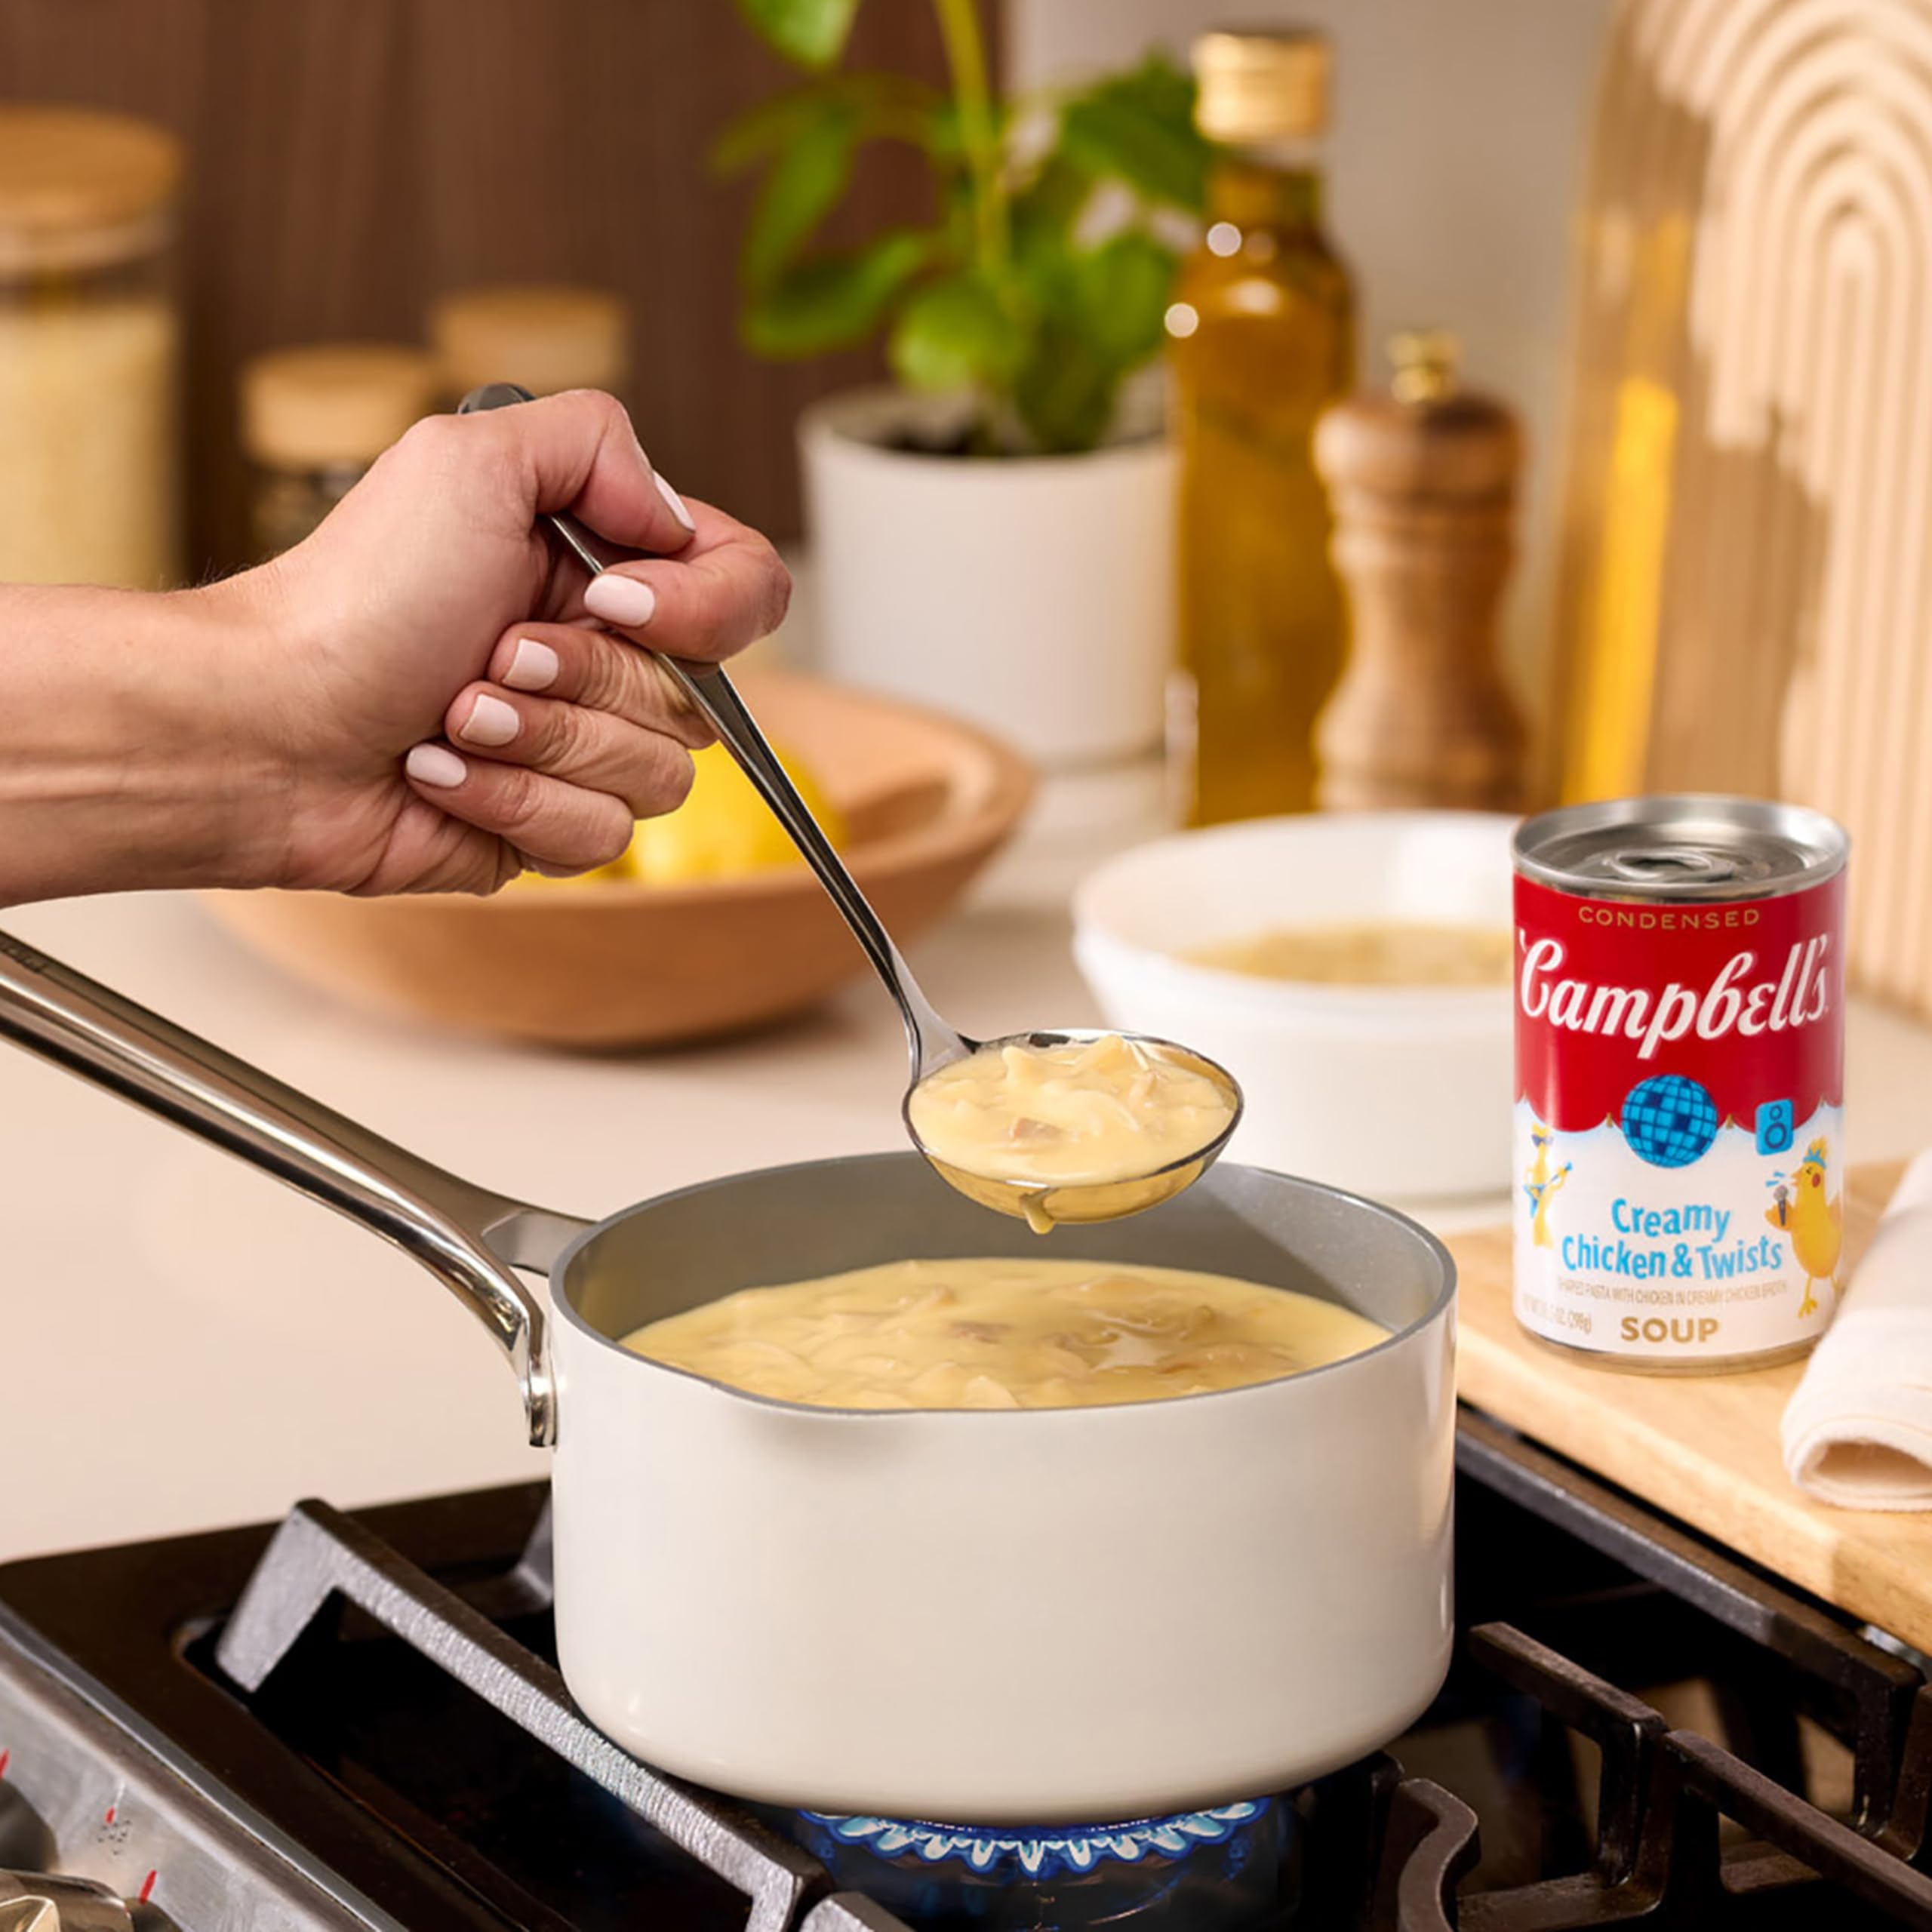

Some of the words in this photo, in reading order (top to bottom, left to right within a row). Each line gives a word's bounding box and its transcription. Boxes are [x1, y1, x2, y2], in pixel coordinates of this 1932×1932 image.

[1578, 906, 1760, 930] CONDENSED
[1519, 928, 1828, 1060] Campbell's
[1611, 1198, 1730, 1243] Creamy
[1561, 1235, 1666, 1280] Chicken
[1671, 1242, 1693, 1278] &
[1696, 1236, 1783, 1281] Twists
[1611, 1287, 1635, 1303] WITH
[1675, 1290, 1685, 1305] IN
[1620, 1316, 1720, 1344] SOUP
